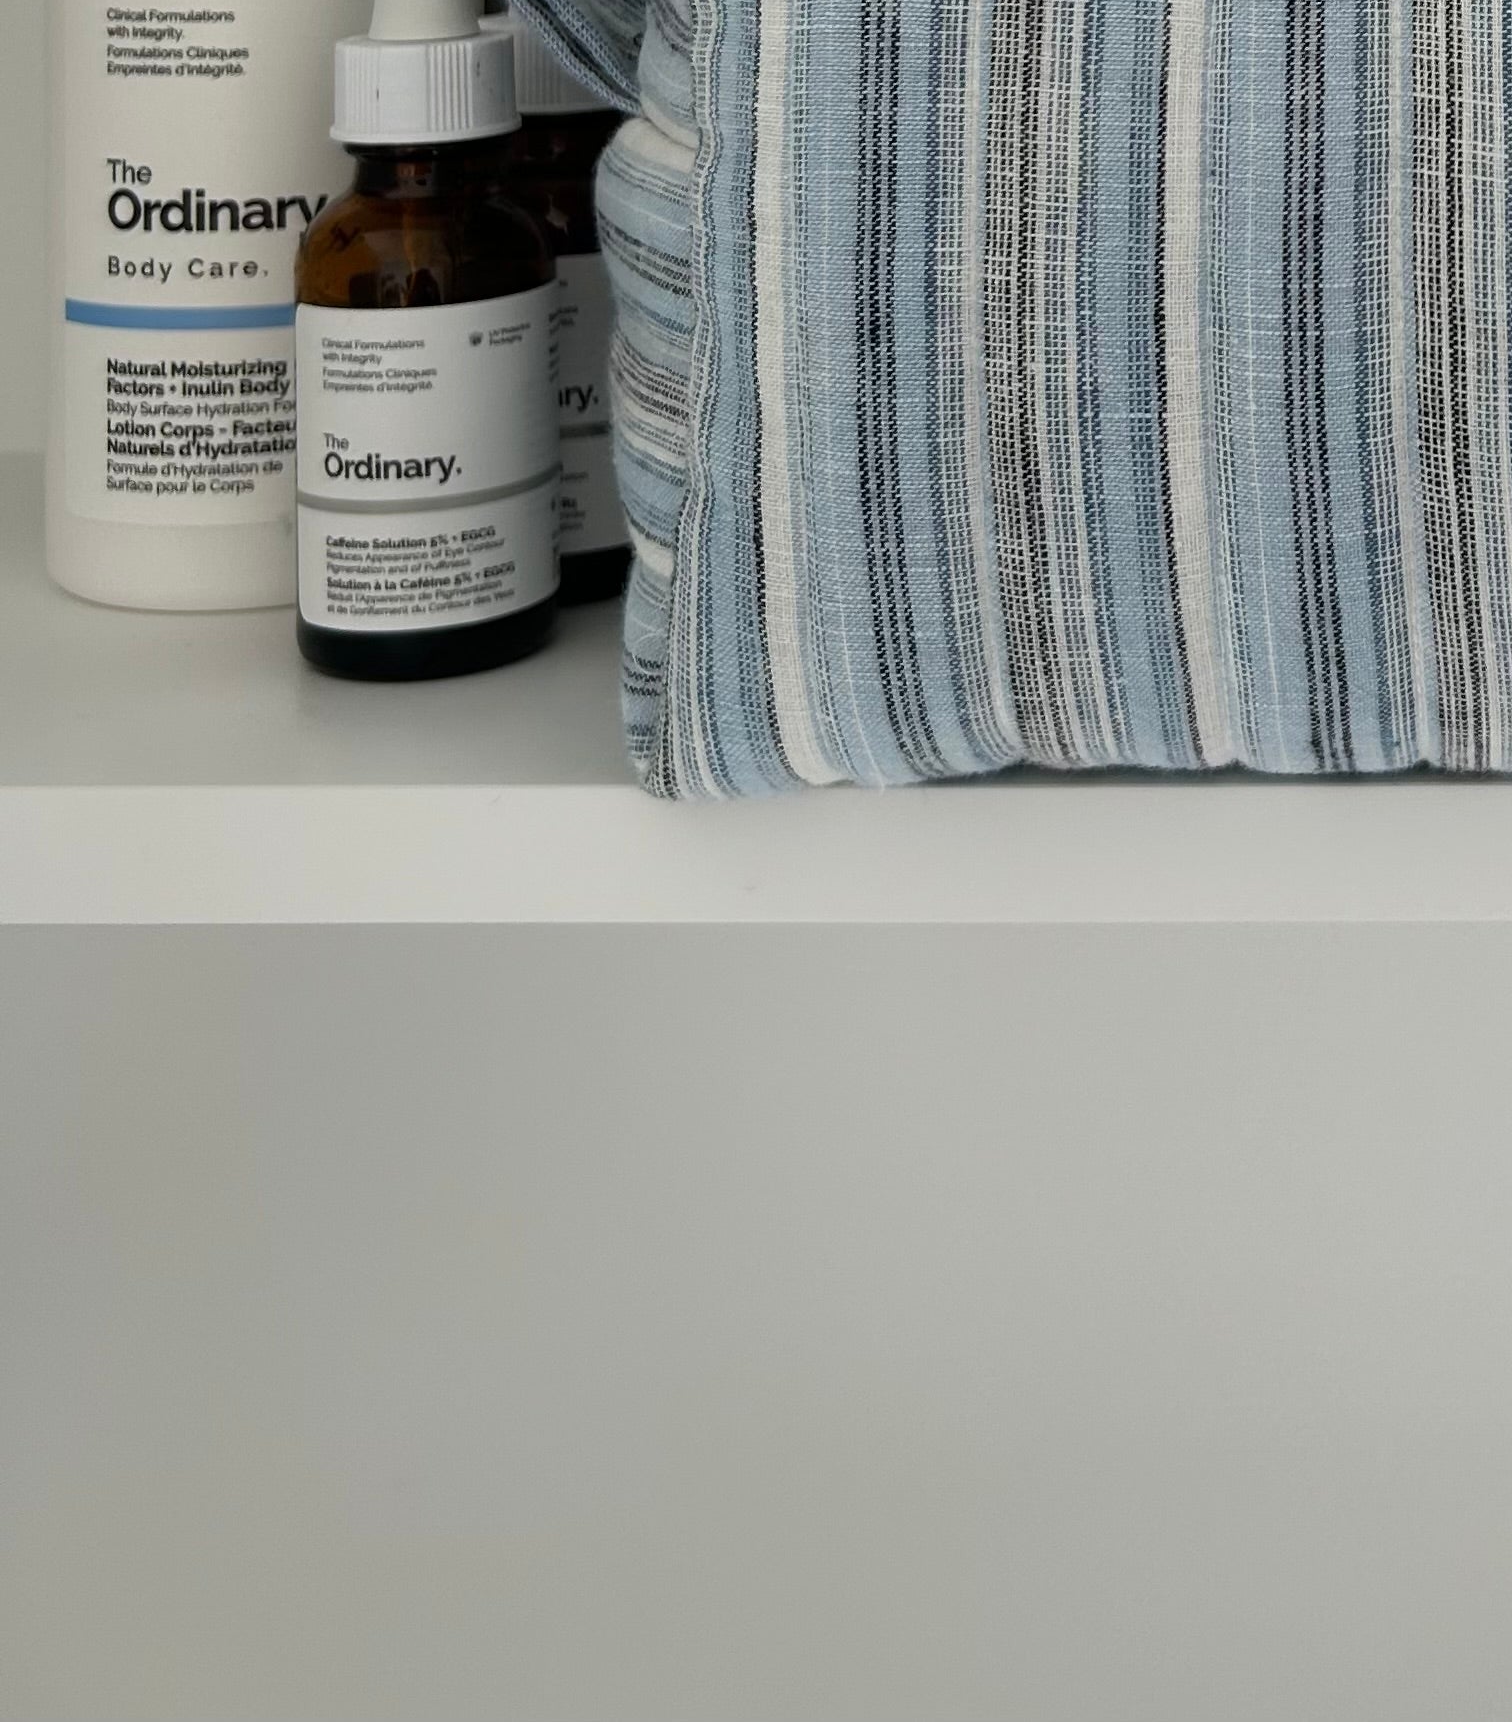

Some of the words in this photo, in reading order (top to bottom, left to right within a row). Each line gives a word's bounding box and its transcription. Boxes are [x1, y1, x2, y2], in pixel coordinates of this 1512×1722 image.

[107, 8, 146, 21] Clinical
[149, 9, 235, 22] Formulations
[106, 26, 129, 37] with
[107, 44, 183, 58] Formulations
[186, 46, 249, 60] Cliniques
[107, 61, 171, 76] Empreintes
[107, 158, 152, 184] The
[107, 189, 329, 234] Ordinary
[107, 256, 173, 284] Body
[187, 258, 269, 280] Care.
[107, 358, 167, 376] Natural
[171, 359, 288, 378] Moisturizing
[107, 377, 164, 395] Factors
[182, 380, 234, 396] Inulin
[239, 378, 291, 399] Body
[107, 398, 138, 417] Body
[140, 400, 193, 417] Surface
[197, 400, 269, 420] Hydration
[107, 418, 156, 438] Lotion
[160, 421, 214, 445] Corps
[232, 419, 296, 436] Facteu
[324, 432, 349, 451] The
[107, 437, 175, 457] Naturels
[179, 435, 296, 460] d'Hydratatio
[107, 459, 158, 476] Formule
[161, 460, 259, 480] d'Hydratation
[262, 459, 284, 473] de
[324, 451, 462, 486] Ordinary.
[107, 477, 153, 493] Surface
[157, 480, 188, 497] pour
[210, 479, 255, 496] Corps
[326, 535, 369, 549] Caffeine
[372, 537, 427, 549] Solution
[327, 576, 371, 590] Solution
[385, 579, 397, 590] la
